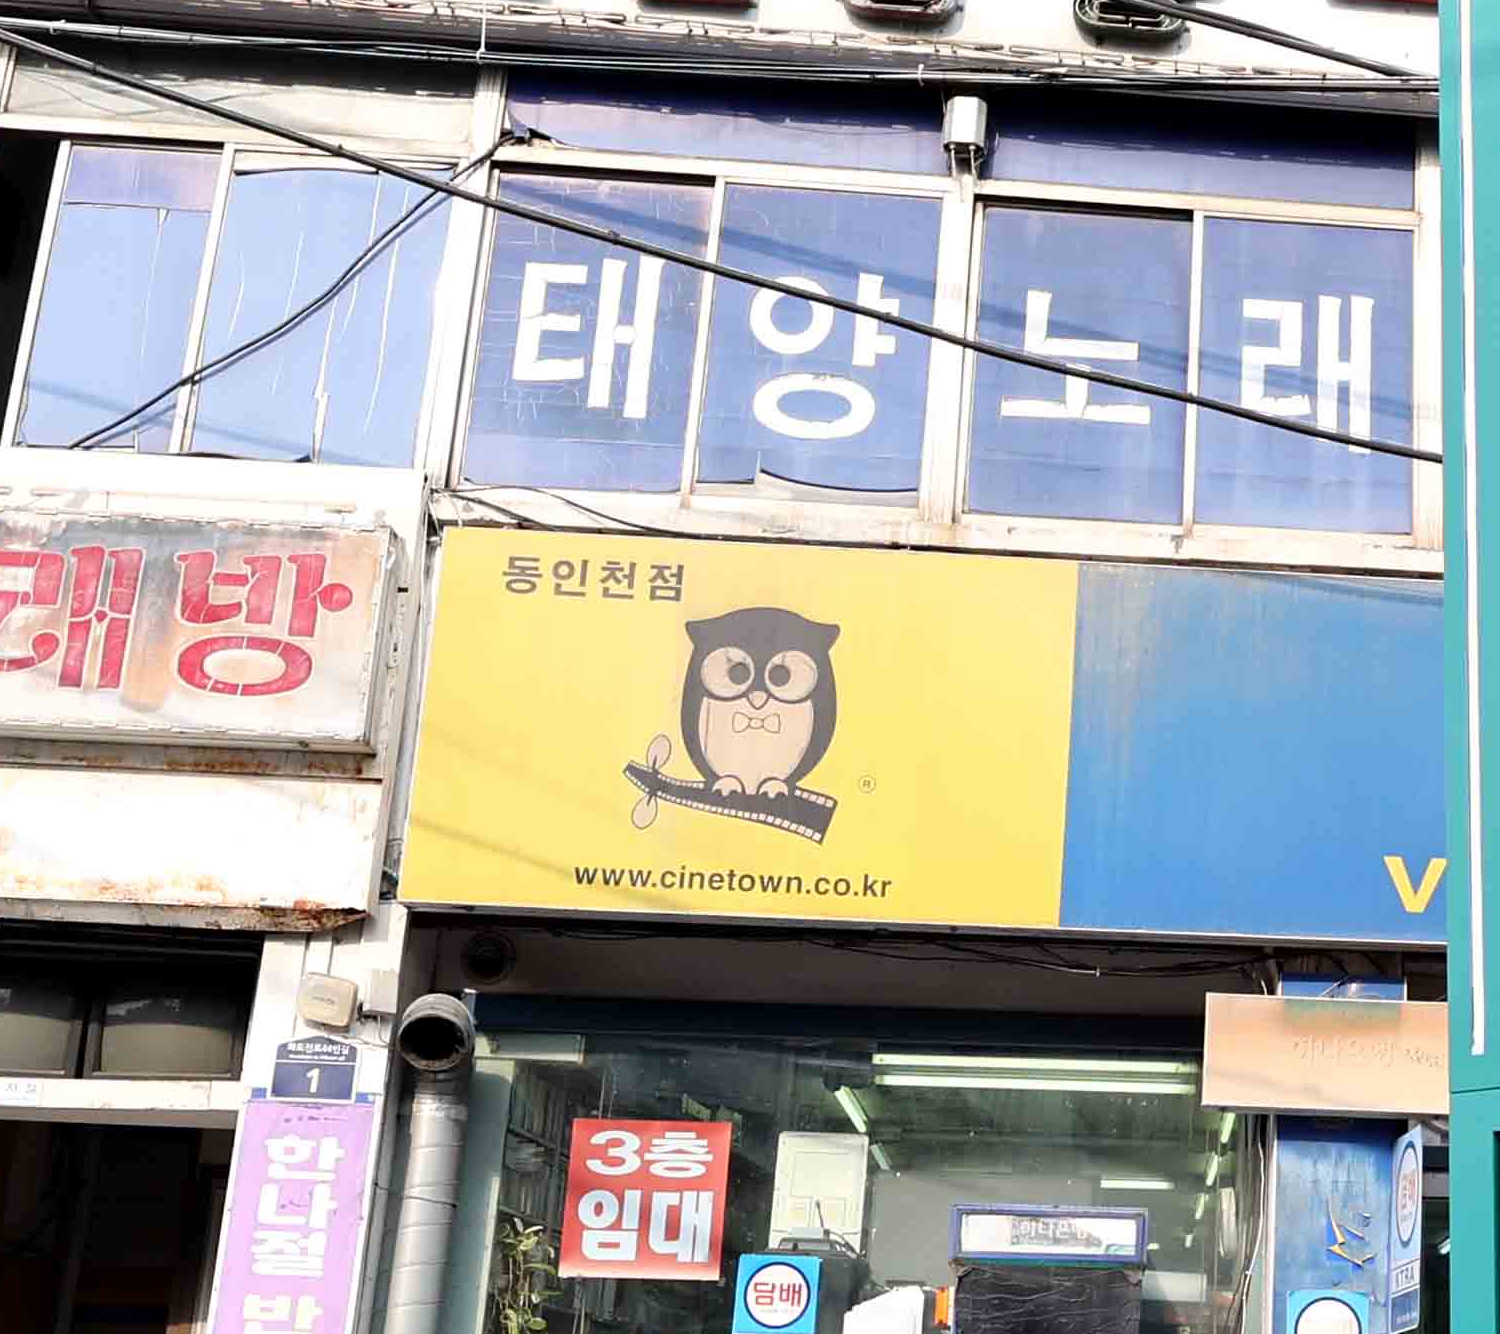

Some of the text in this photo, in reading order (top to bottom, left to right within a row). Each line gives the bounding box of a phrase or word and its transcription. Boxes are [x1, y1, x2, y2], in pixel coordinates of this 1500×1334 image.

[500, 553, 688, 604] 동인천점
[572, 863, 894, 902] www.cinetown.co.kr
[306, 1066, 321, 1094] 1
[584, 1128, 714, 1179] 3층
[250, 1132, 347, 1278] 한나절
[577, 1189, 714, 1264] 임대
[752, 1280, 803, 1309] 담배
